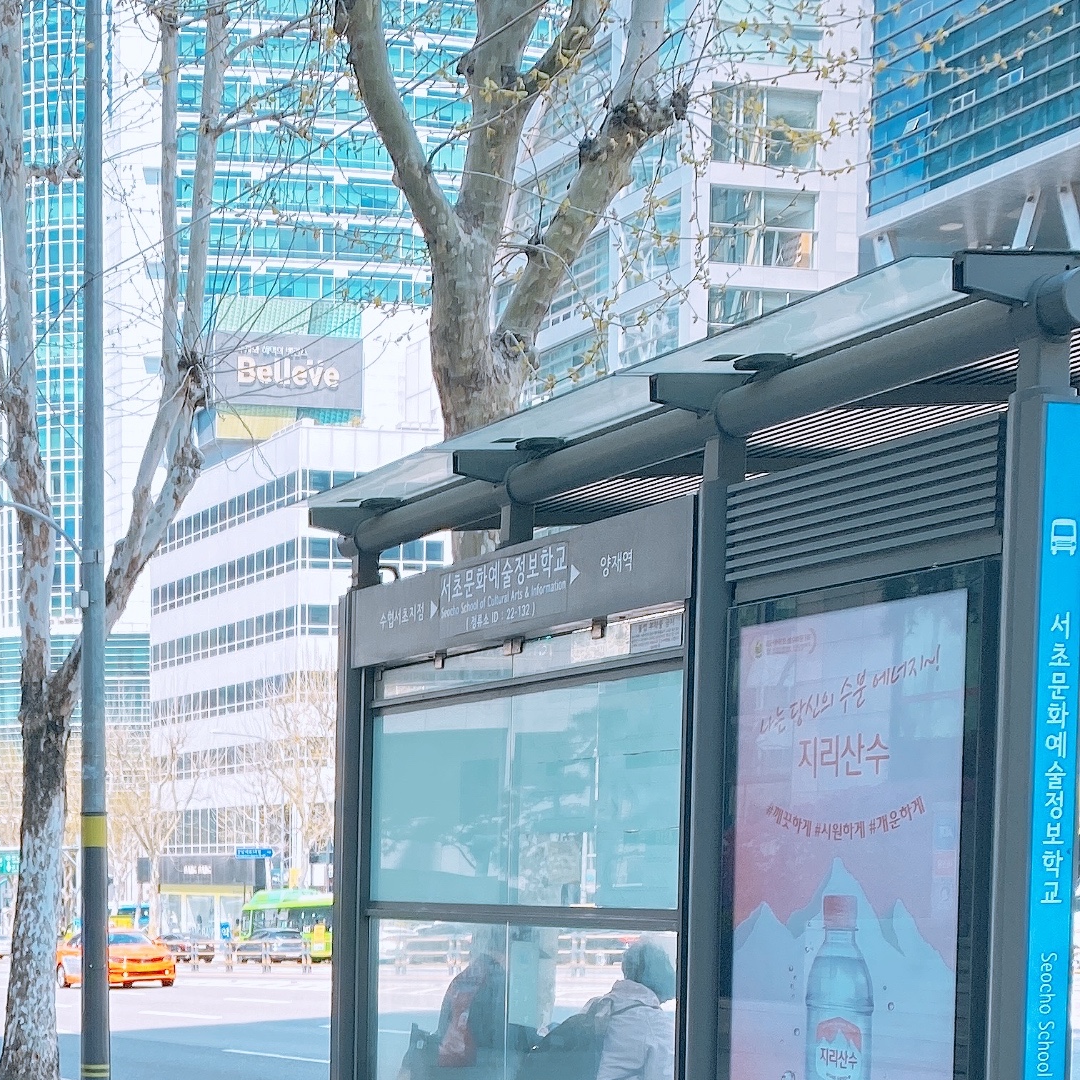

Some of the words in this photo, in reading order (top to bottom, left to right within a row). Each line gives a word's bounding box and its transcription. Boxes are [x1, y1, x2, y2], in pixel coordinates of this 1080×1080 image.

[440, 545, 568, 602] 서초문화예술정보학교
[600, 549, 633, 577] 양재역
[380, 602, 424, 631] 수협서초지점
[440, 605, 460, 619] Seocho
[461, 599, 479, 614] School
[480, 596, 486, 609] of
[487, 590, 510, 607] Cultural
[510, 589, 523, 602] Arts
[524, 586, 530, 598] &
[530, 580, 567, 597] Information
[760, 706, 787, 734] 나는
[789, 690, 834, 727] 당신의
[839, 668, 867, 714] 수분
[798, 732, 890, 779] 지리산수
[1039, 611, 1072, 905] 서초문화예술정보학교
[765, 803, 813, 838] #깨끗하게
[814, 820, 866, 841] #시원하게
[868, 795, 926, 835] #개운하게
[1038, 952, 1058, 1015] Seocho
[819, 1047, 858, 1071] 지리산수
[1036, 1021, 1055, 1077] School
